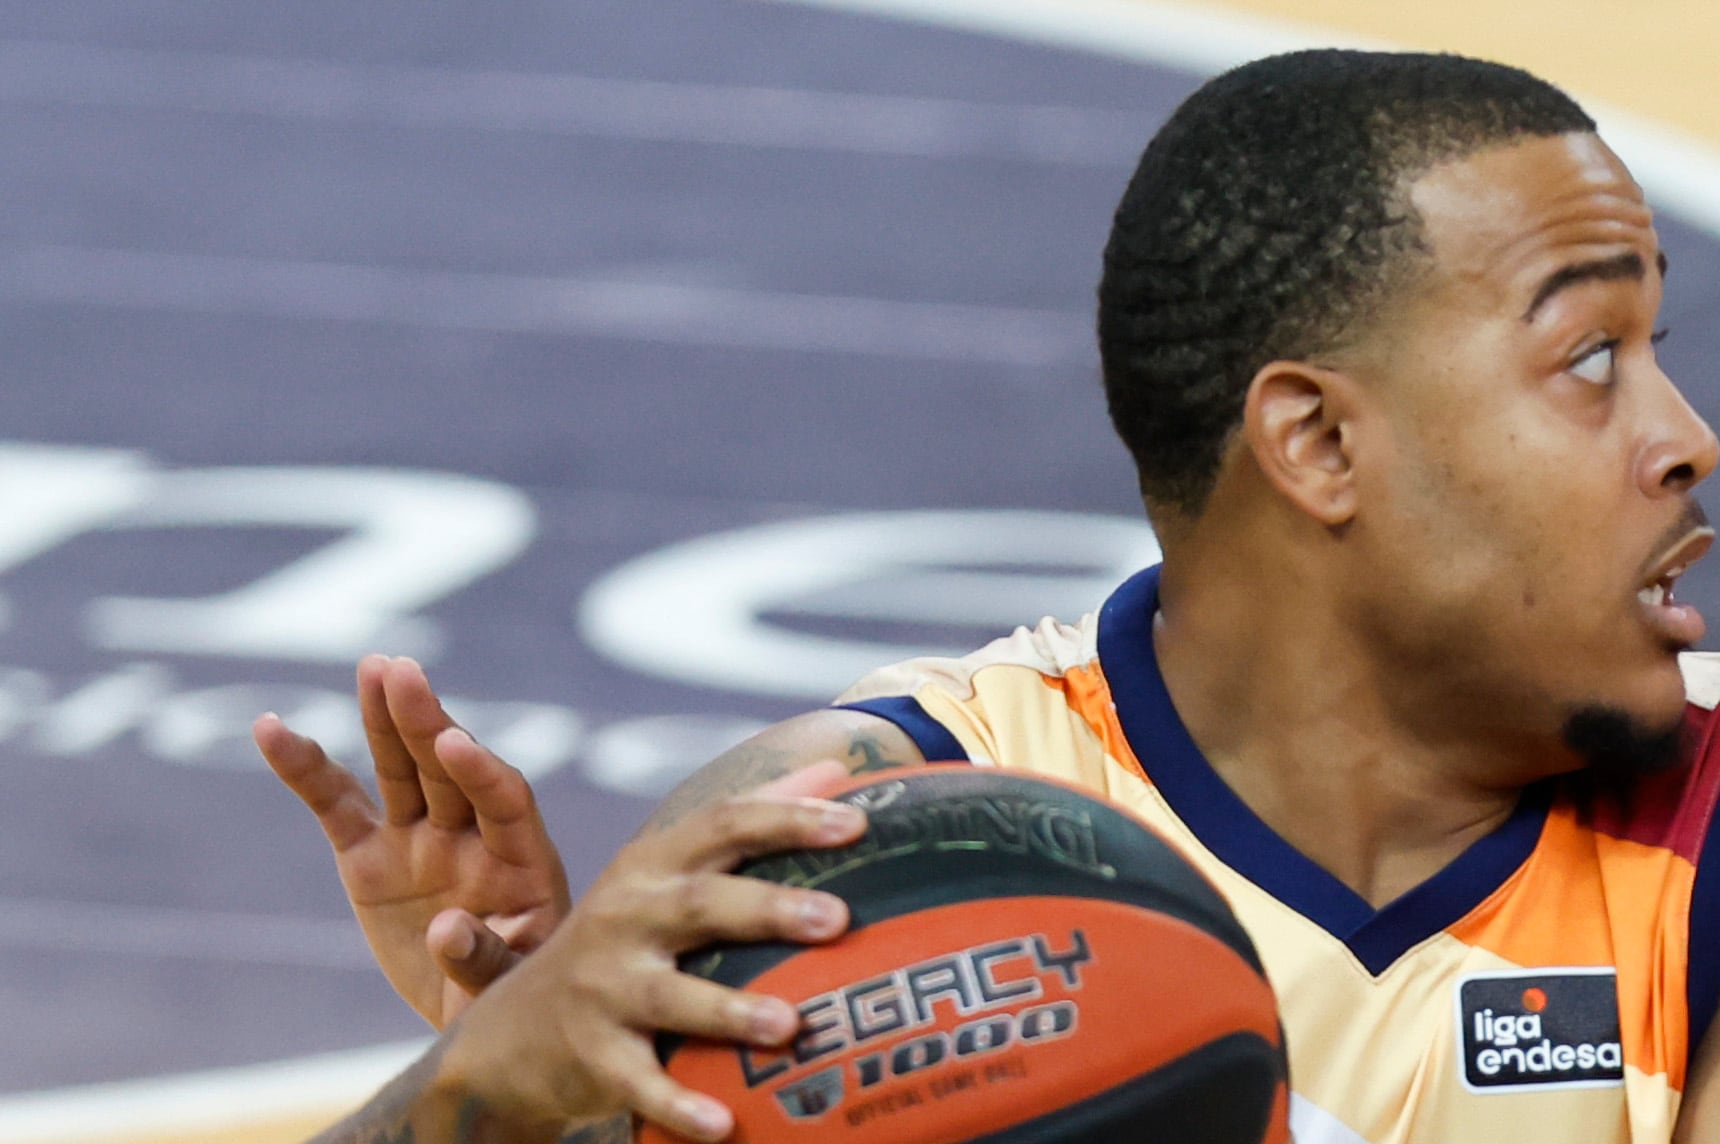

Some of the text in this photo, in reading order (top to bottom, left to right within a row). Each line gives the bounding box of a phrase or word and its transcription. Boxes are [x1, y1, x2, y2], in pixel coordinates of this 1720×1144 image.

[737, 928, 1093, 1090] LEGACY
[1474, 1008, 1542, 1047] liga
[852, 1000, 1079, 1090] 1000
[1476, 1038, 1622, 1076] endesa
